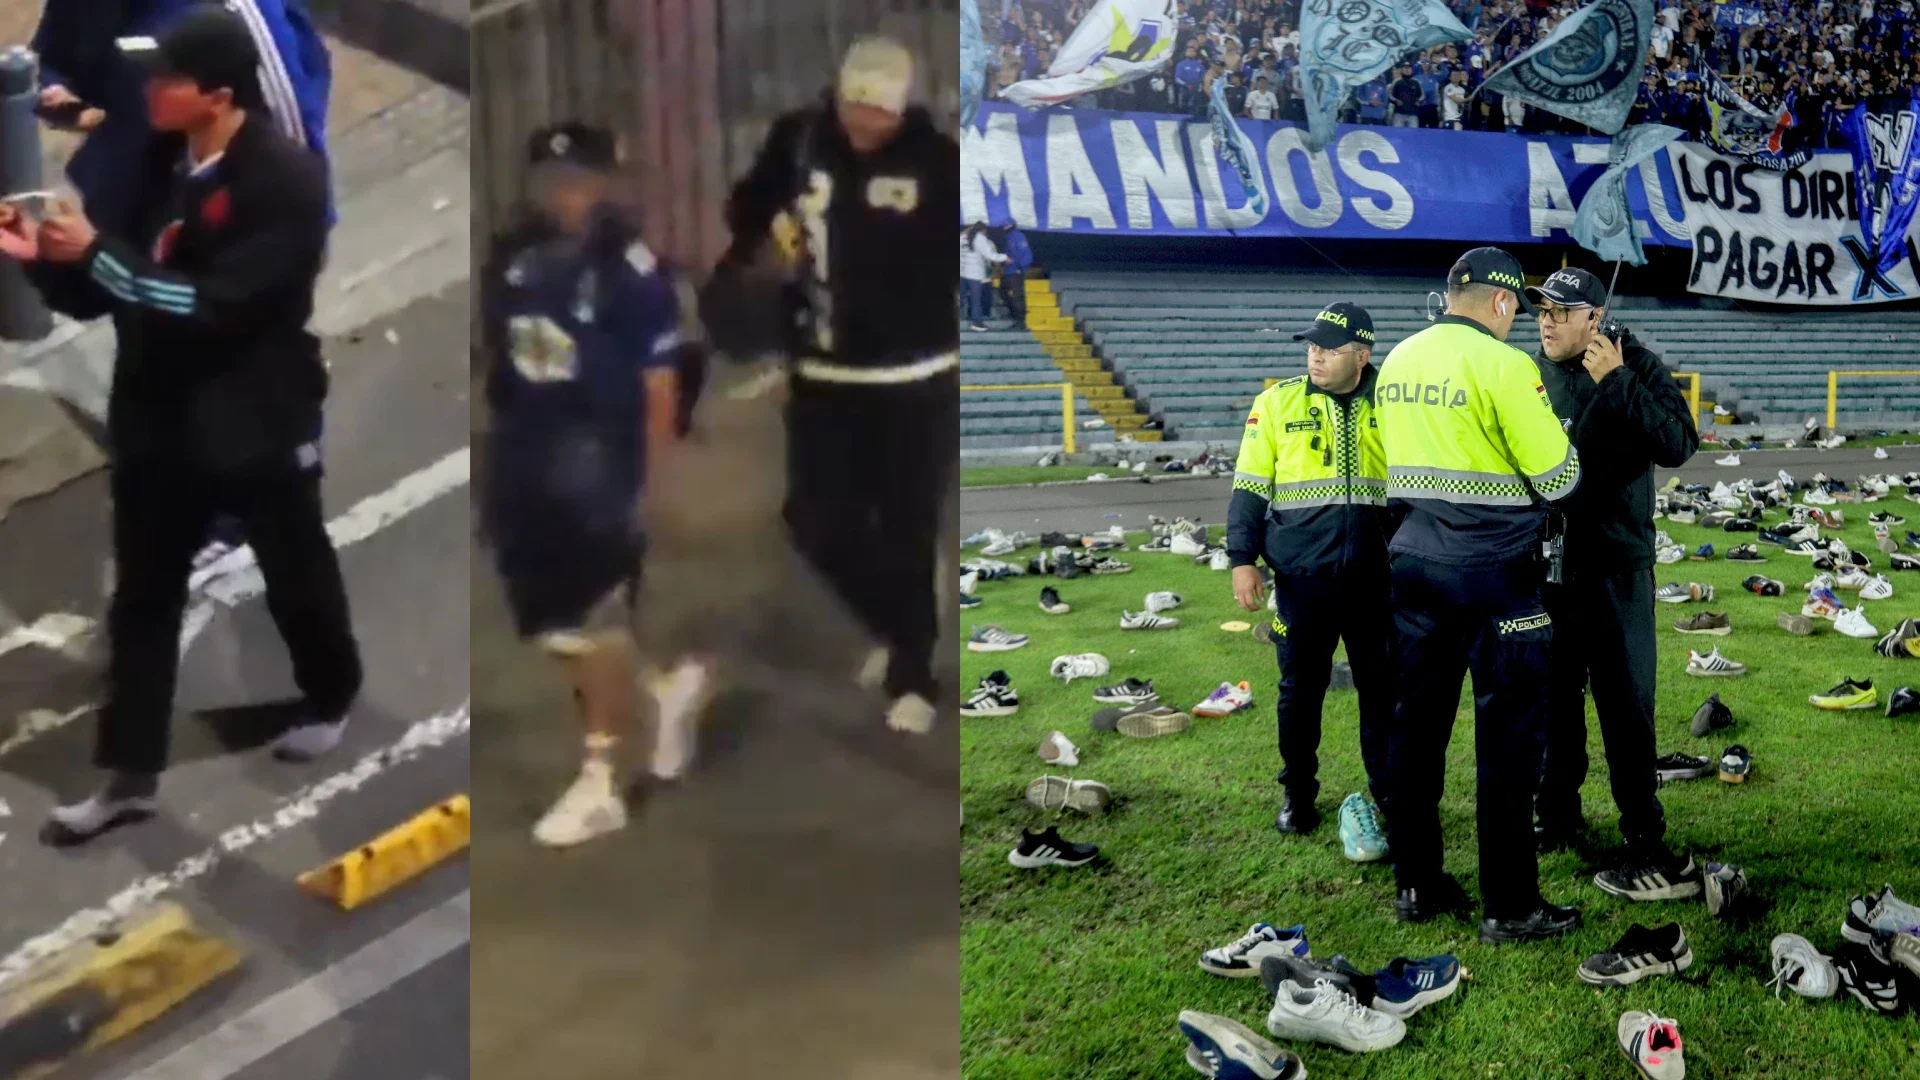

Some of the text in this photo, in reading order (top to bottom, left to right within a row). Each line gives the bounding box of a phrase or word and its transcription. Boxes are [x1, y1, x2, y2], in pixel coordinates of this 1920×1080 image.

[960, 112, 1415, 231] MANDOS
[1678, 153, 1761, 214] LOS
[1546, 271, 1581, 289] LICÍA
[1690, 225, 1839, 300] PAGAR
[1839, 234, 1907, 301] X
[1315, 310, 1348, 328] LICÍA
[1376, 377, 1468, 409] POLICÍA
